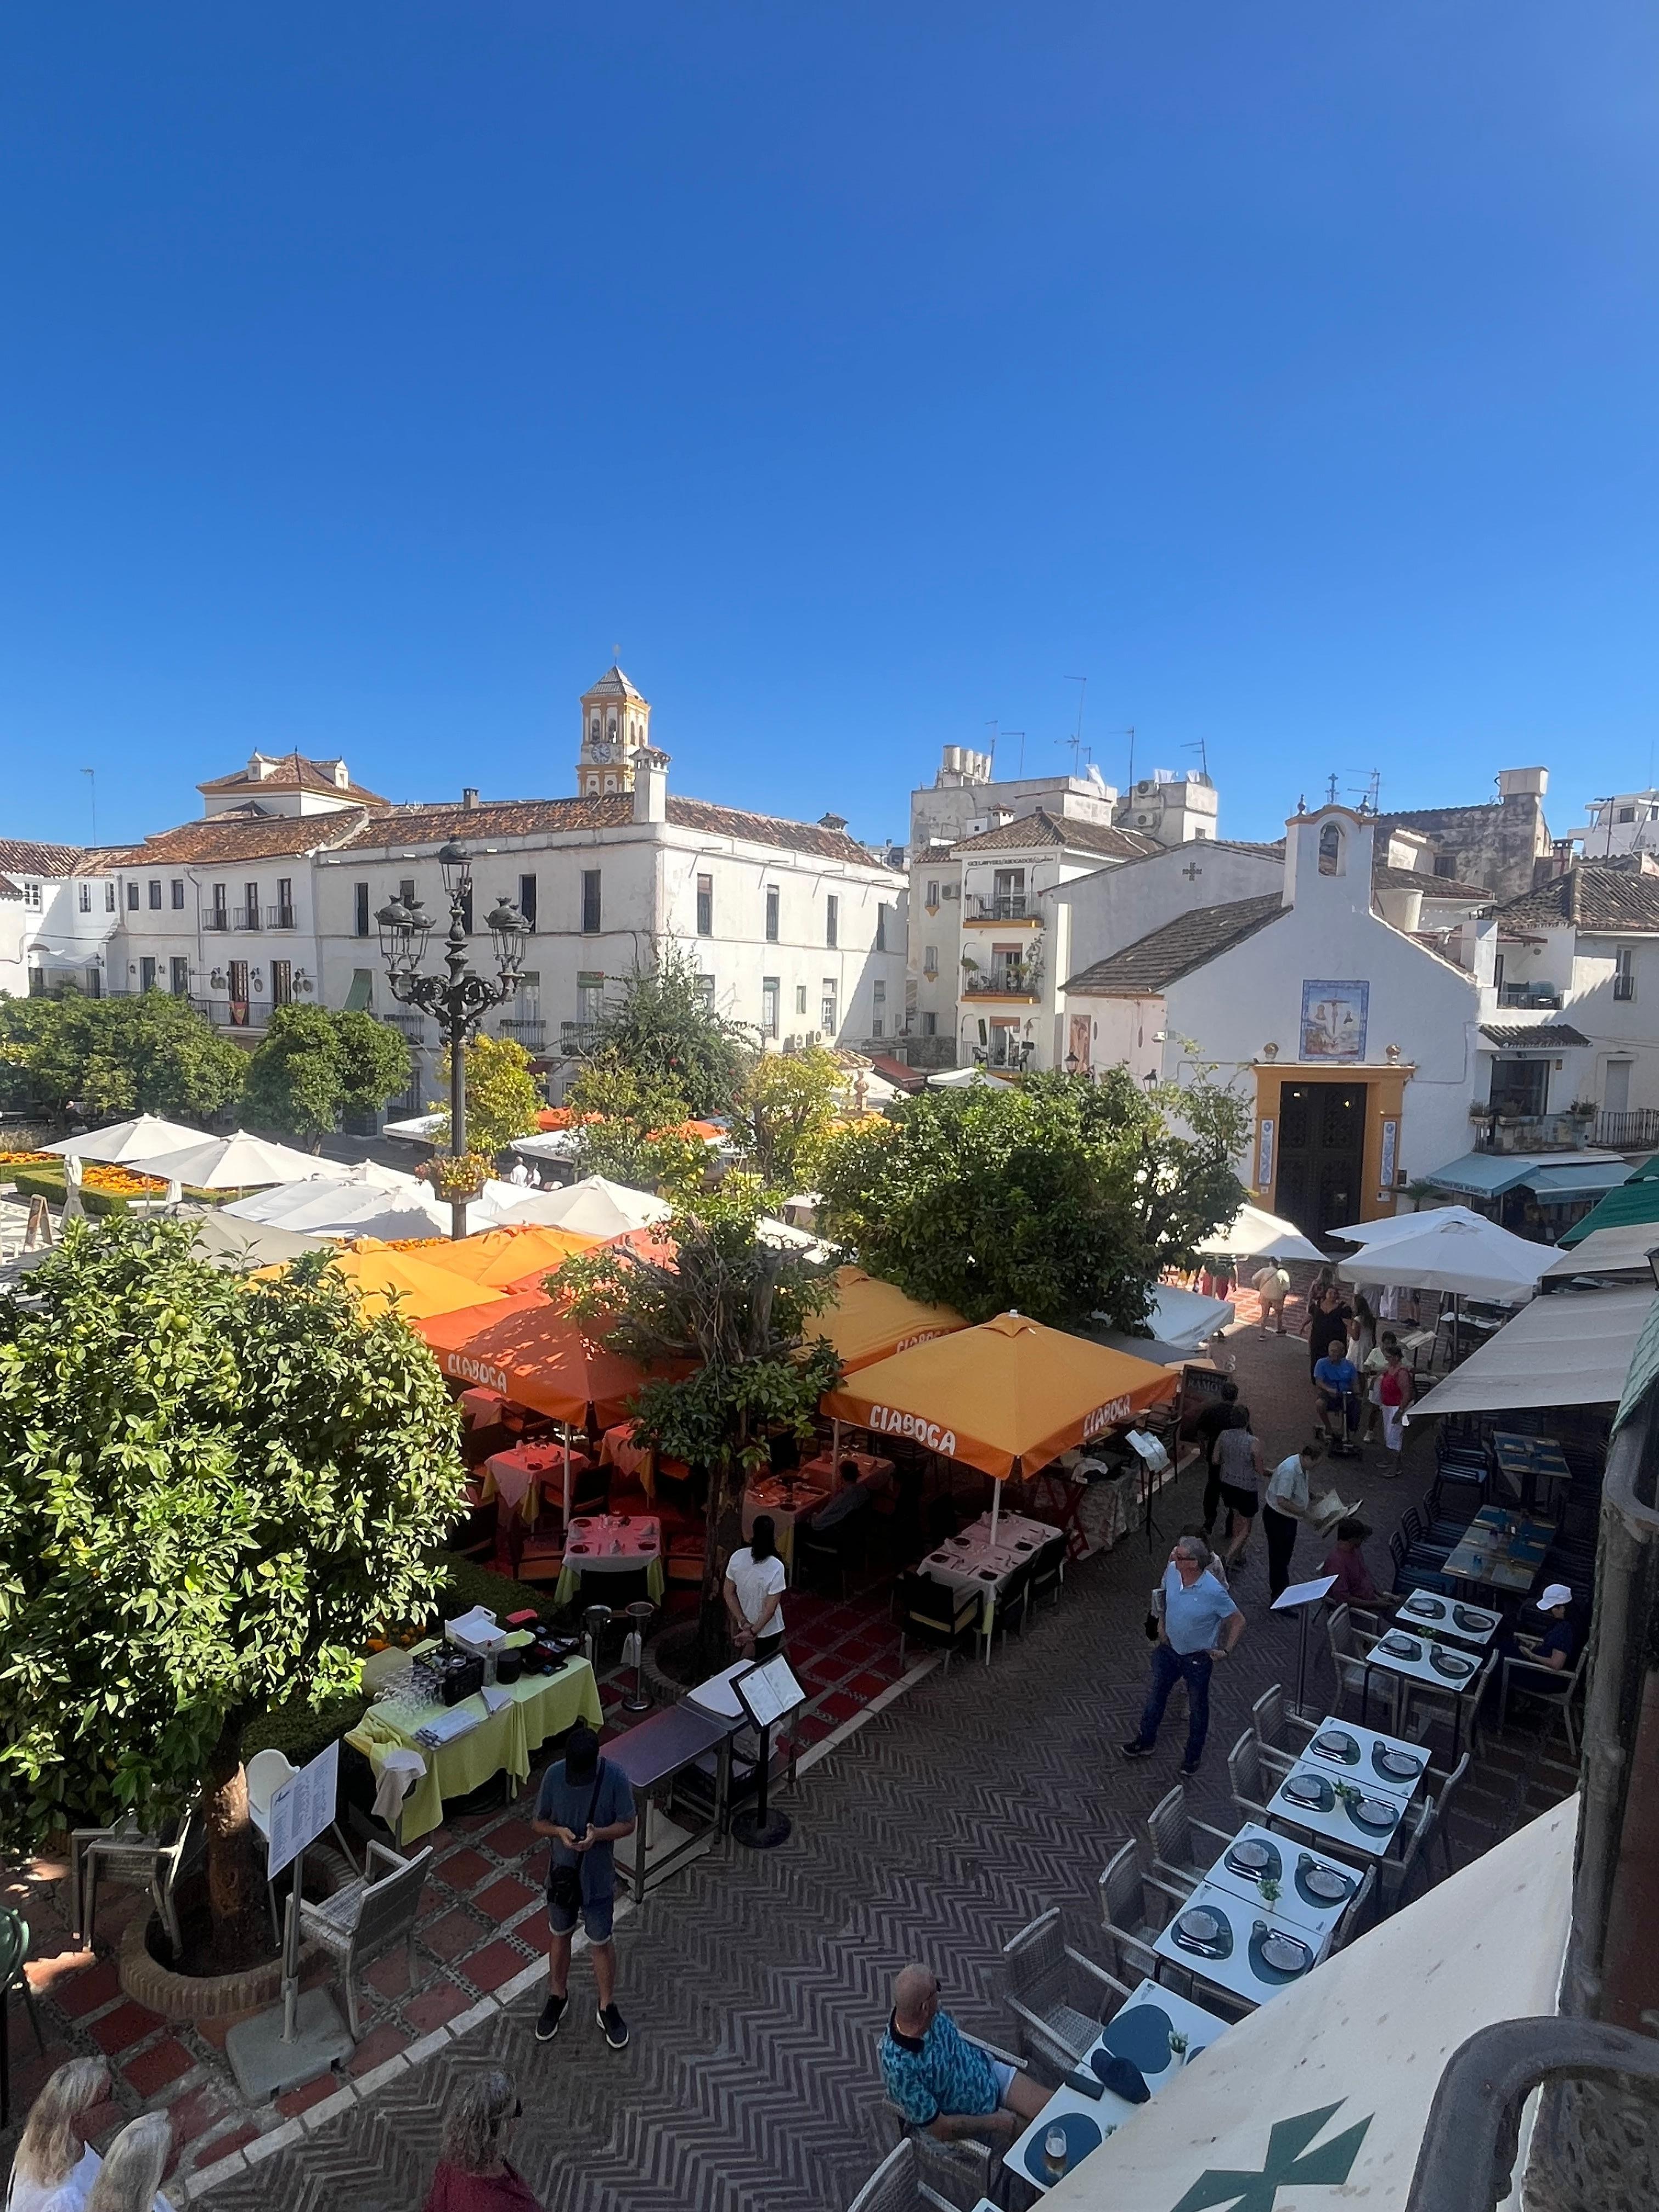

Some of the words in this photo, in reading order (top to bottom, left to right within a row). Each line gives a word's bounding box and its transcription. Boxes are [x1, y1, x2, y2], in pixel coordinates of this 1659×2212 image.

[448, 1353, 507, 1394] CIABOCA
[870, 1404, 956, 1456] CIABOCA
[1084, 1394, 1130, 1437] CIABOCA
